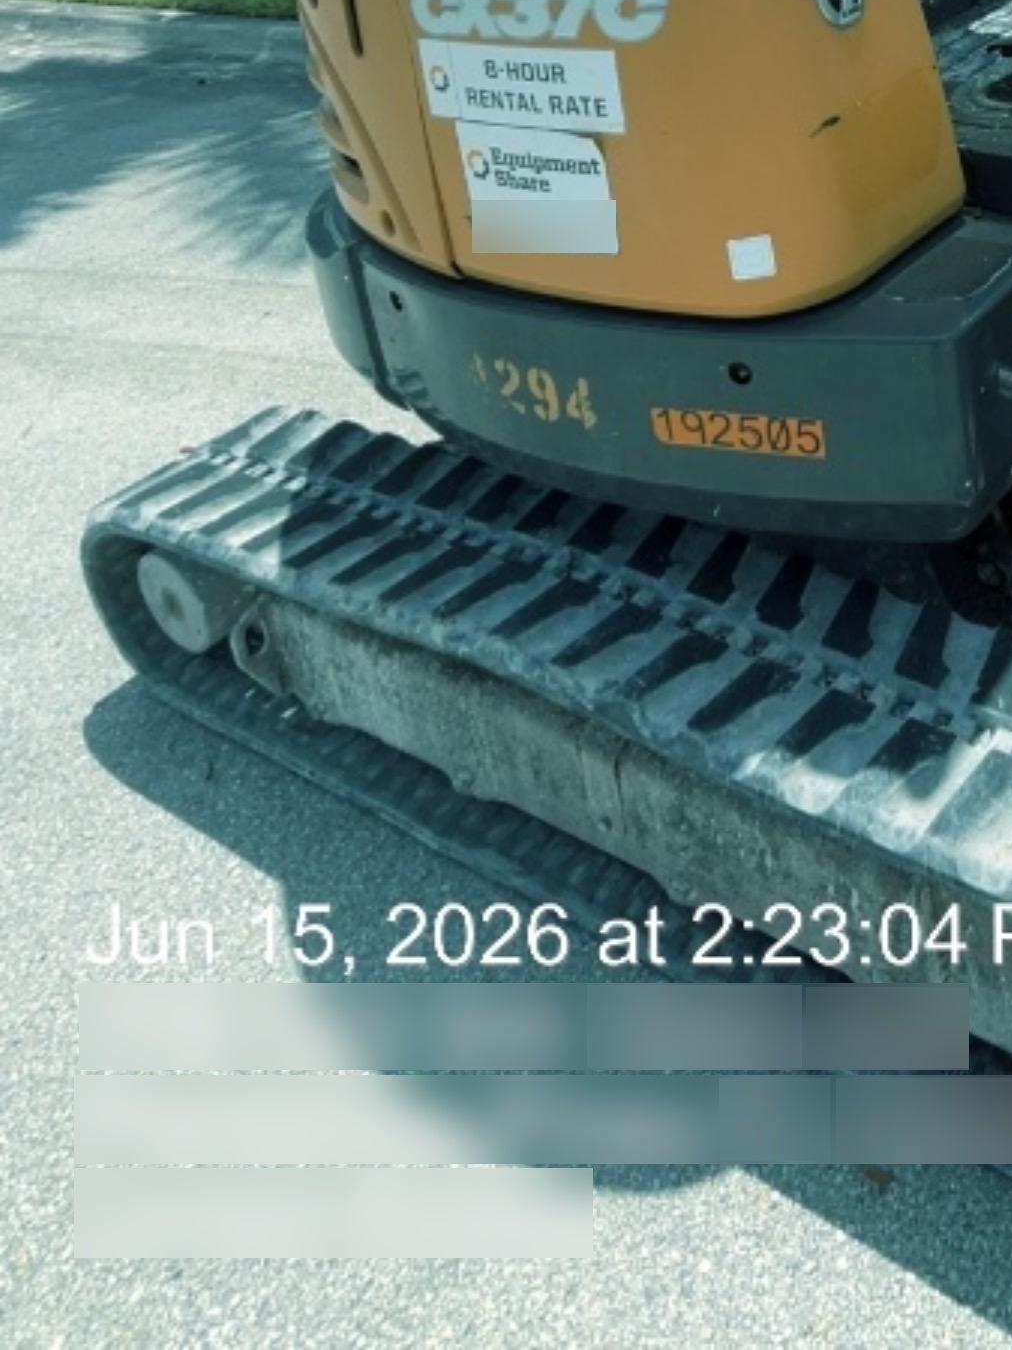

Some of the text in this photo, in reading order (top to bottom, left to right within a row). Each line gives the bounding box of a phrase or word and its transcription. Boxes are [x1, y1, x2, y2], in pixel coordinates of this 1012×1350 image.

[483, 58, 567, 85] 8-HOUR
[464, 86, 609, 118] RENTAL RATE
[488, 146, 602, 176] Equipment
[494, 170, 552, 193] Share
[656, 409, 821, 454] 192505
